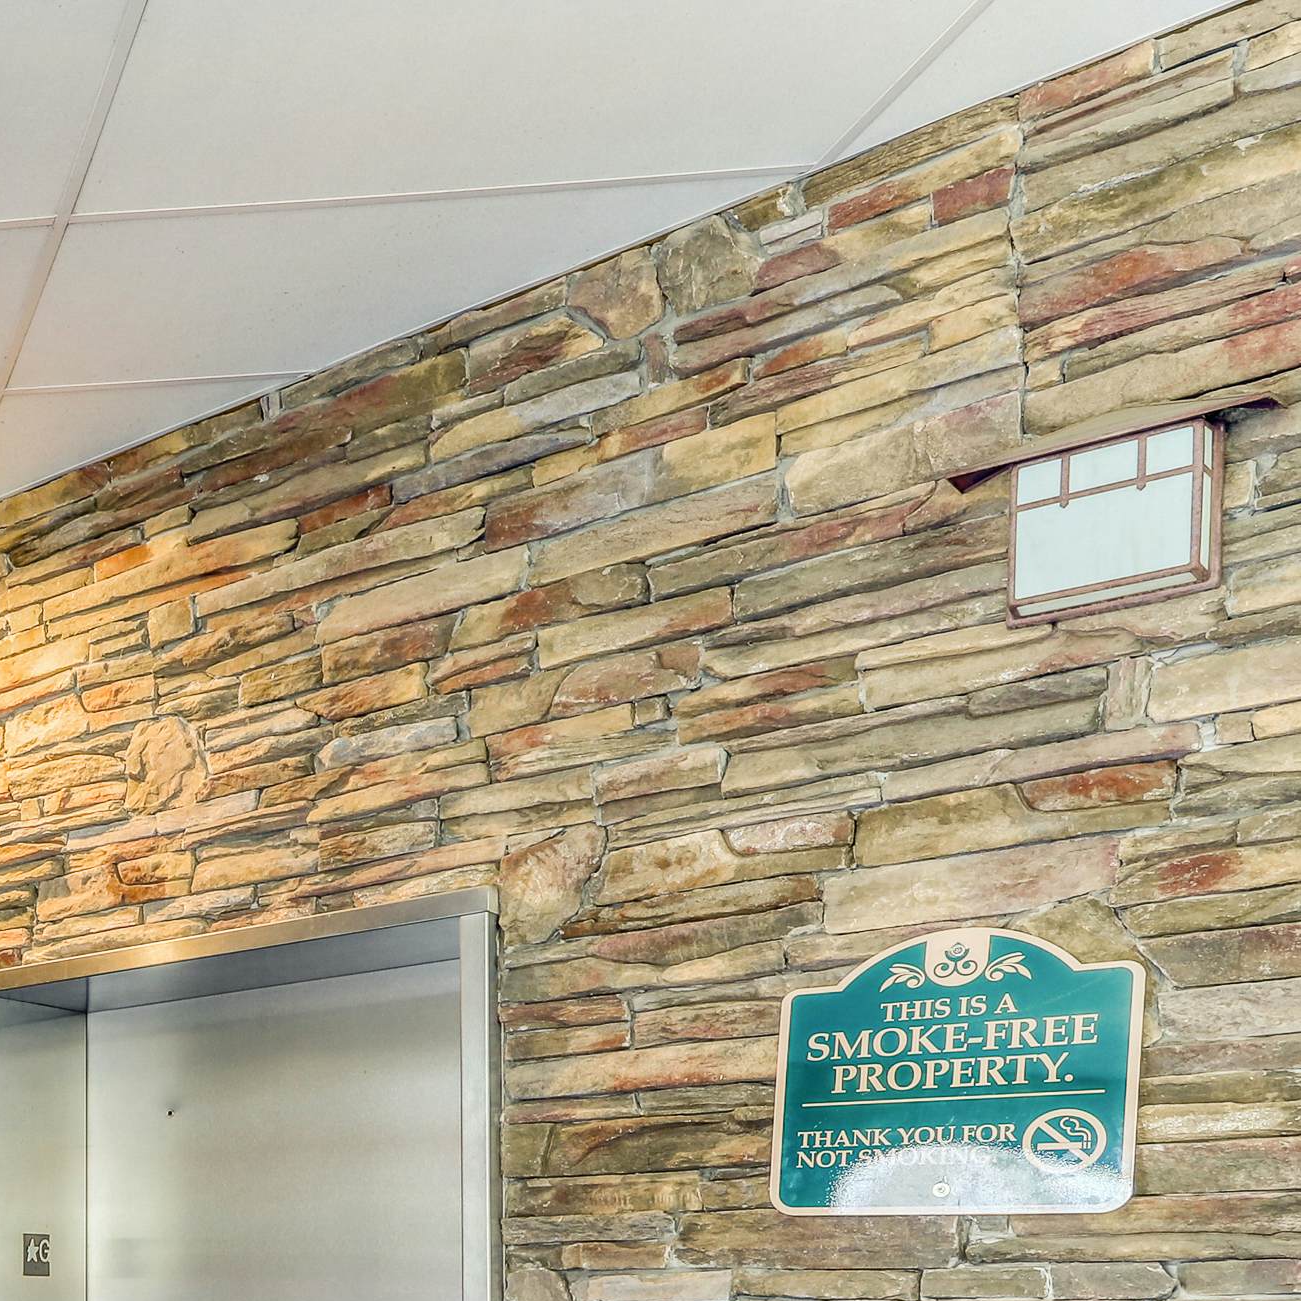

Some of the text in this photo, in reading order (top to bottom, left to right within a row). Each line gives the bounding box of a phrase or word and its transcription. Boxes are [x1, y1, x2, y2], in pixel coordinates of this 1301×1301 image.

[880, 992, 1018, 1022] THIS IS A
[806, 1014, 1099, 1062] SMOKE-FREE
[830, 1052, 1074, 1094] PROPERTY.
[797, 1123, 1018, 1149] THANK YOU FOR
[795, 1149, 854, 1169] NOT
[39, 1239, 50, 1263] G
